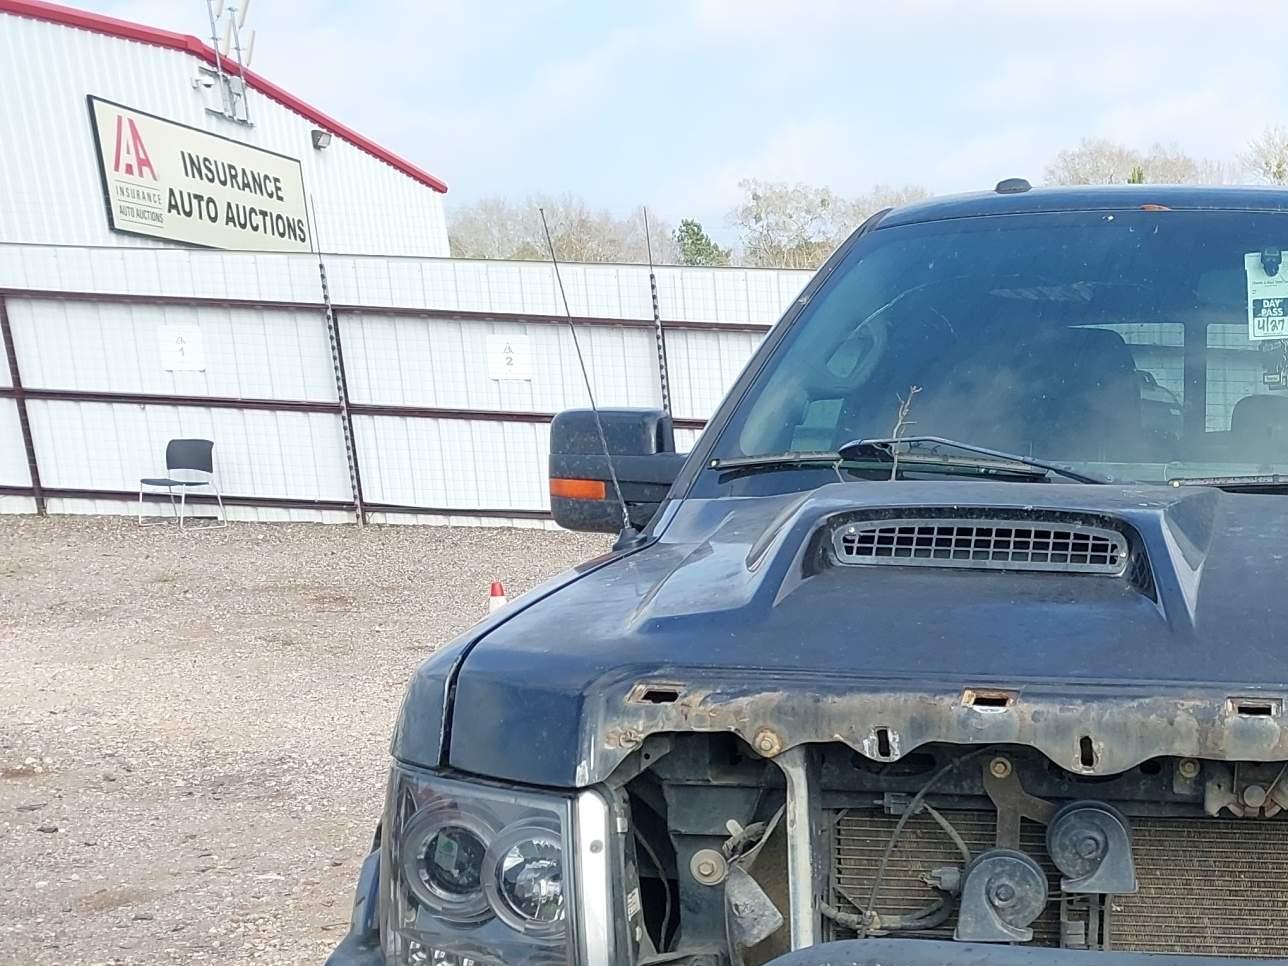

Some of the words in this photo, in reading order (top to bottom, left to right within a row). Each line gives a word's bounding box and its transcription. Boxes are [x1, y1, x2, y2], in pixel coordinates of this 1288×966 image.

[180, 151, 284, 202] INSURANCE
[115, 185, 161, 205] INSURANCE
[119, 205, 135, 217] AUTO
[136, 208, 164, 223] AUCTIONS
[167, 188, 218, 224] AUTO
[225, 202, 306, 243] AUCTIONS
[1261, 308, 1283, 316] PASS
[1263, 299, 1283, 308] DAY
